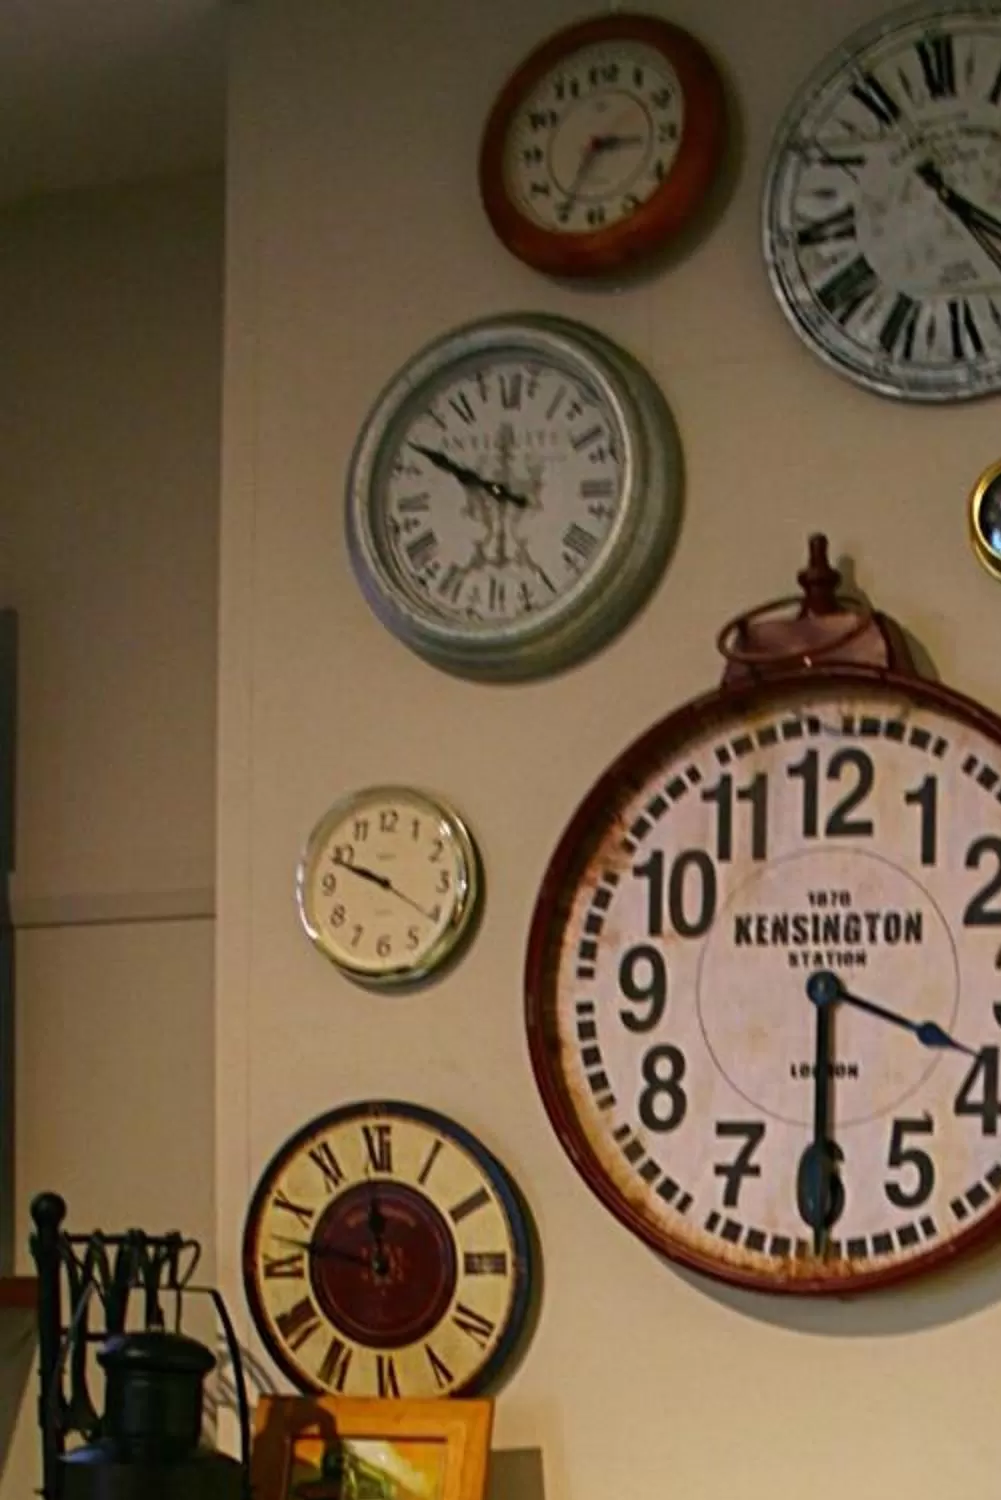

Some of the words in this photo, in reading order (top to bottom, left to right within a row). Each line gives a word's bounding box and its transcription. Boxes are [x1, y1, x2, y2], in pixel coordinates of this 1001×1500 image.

[786, 748, 875, 838] 12
[353, 819, 370, 842] 11
[378, 809, 400, 833] 12
[411, 818, 421, 843] 1
[701, 773, 769, 863] 11
[904, 774, 938, 867] 1
[427, 839, 445, 864] 2
[321, 872, 337, 898] 9
[633, 848, 718, 939] 10
[330, 903, 347, 928] 8
[351, 923, 364, 948] 7
[406, 925, 420, 950] 5
[734, 911, 923, 948] KENSINGTON
[375, 934, 392, 958] 6
[789, 951, 868, 968] STATION
[617, 943, 668, 1034] 9
[638, 1043, 688, 1133] 8
[713, 1121, 767, 1209] 7
[883, 1111, 936, 1209] 5
